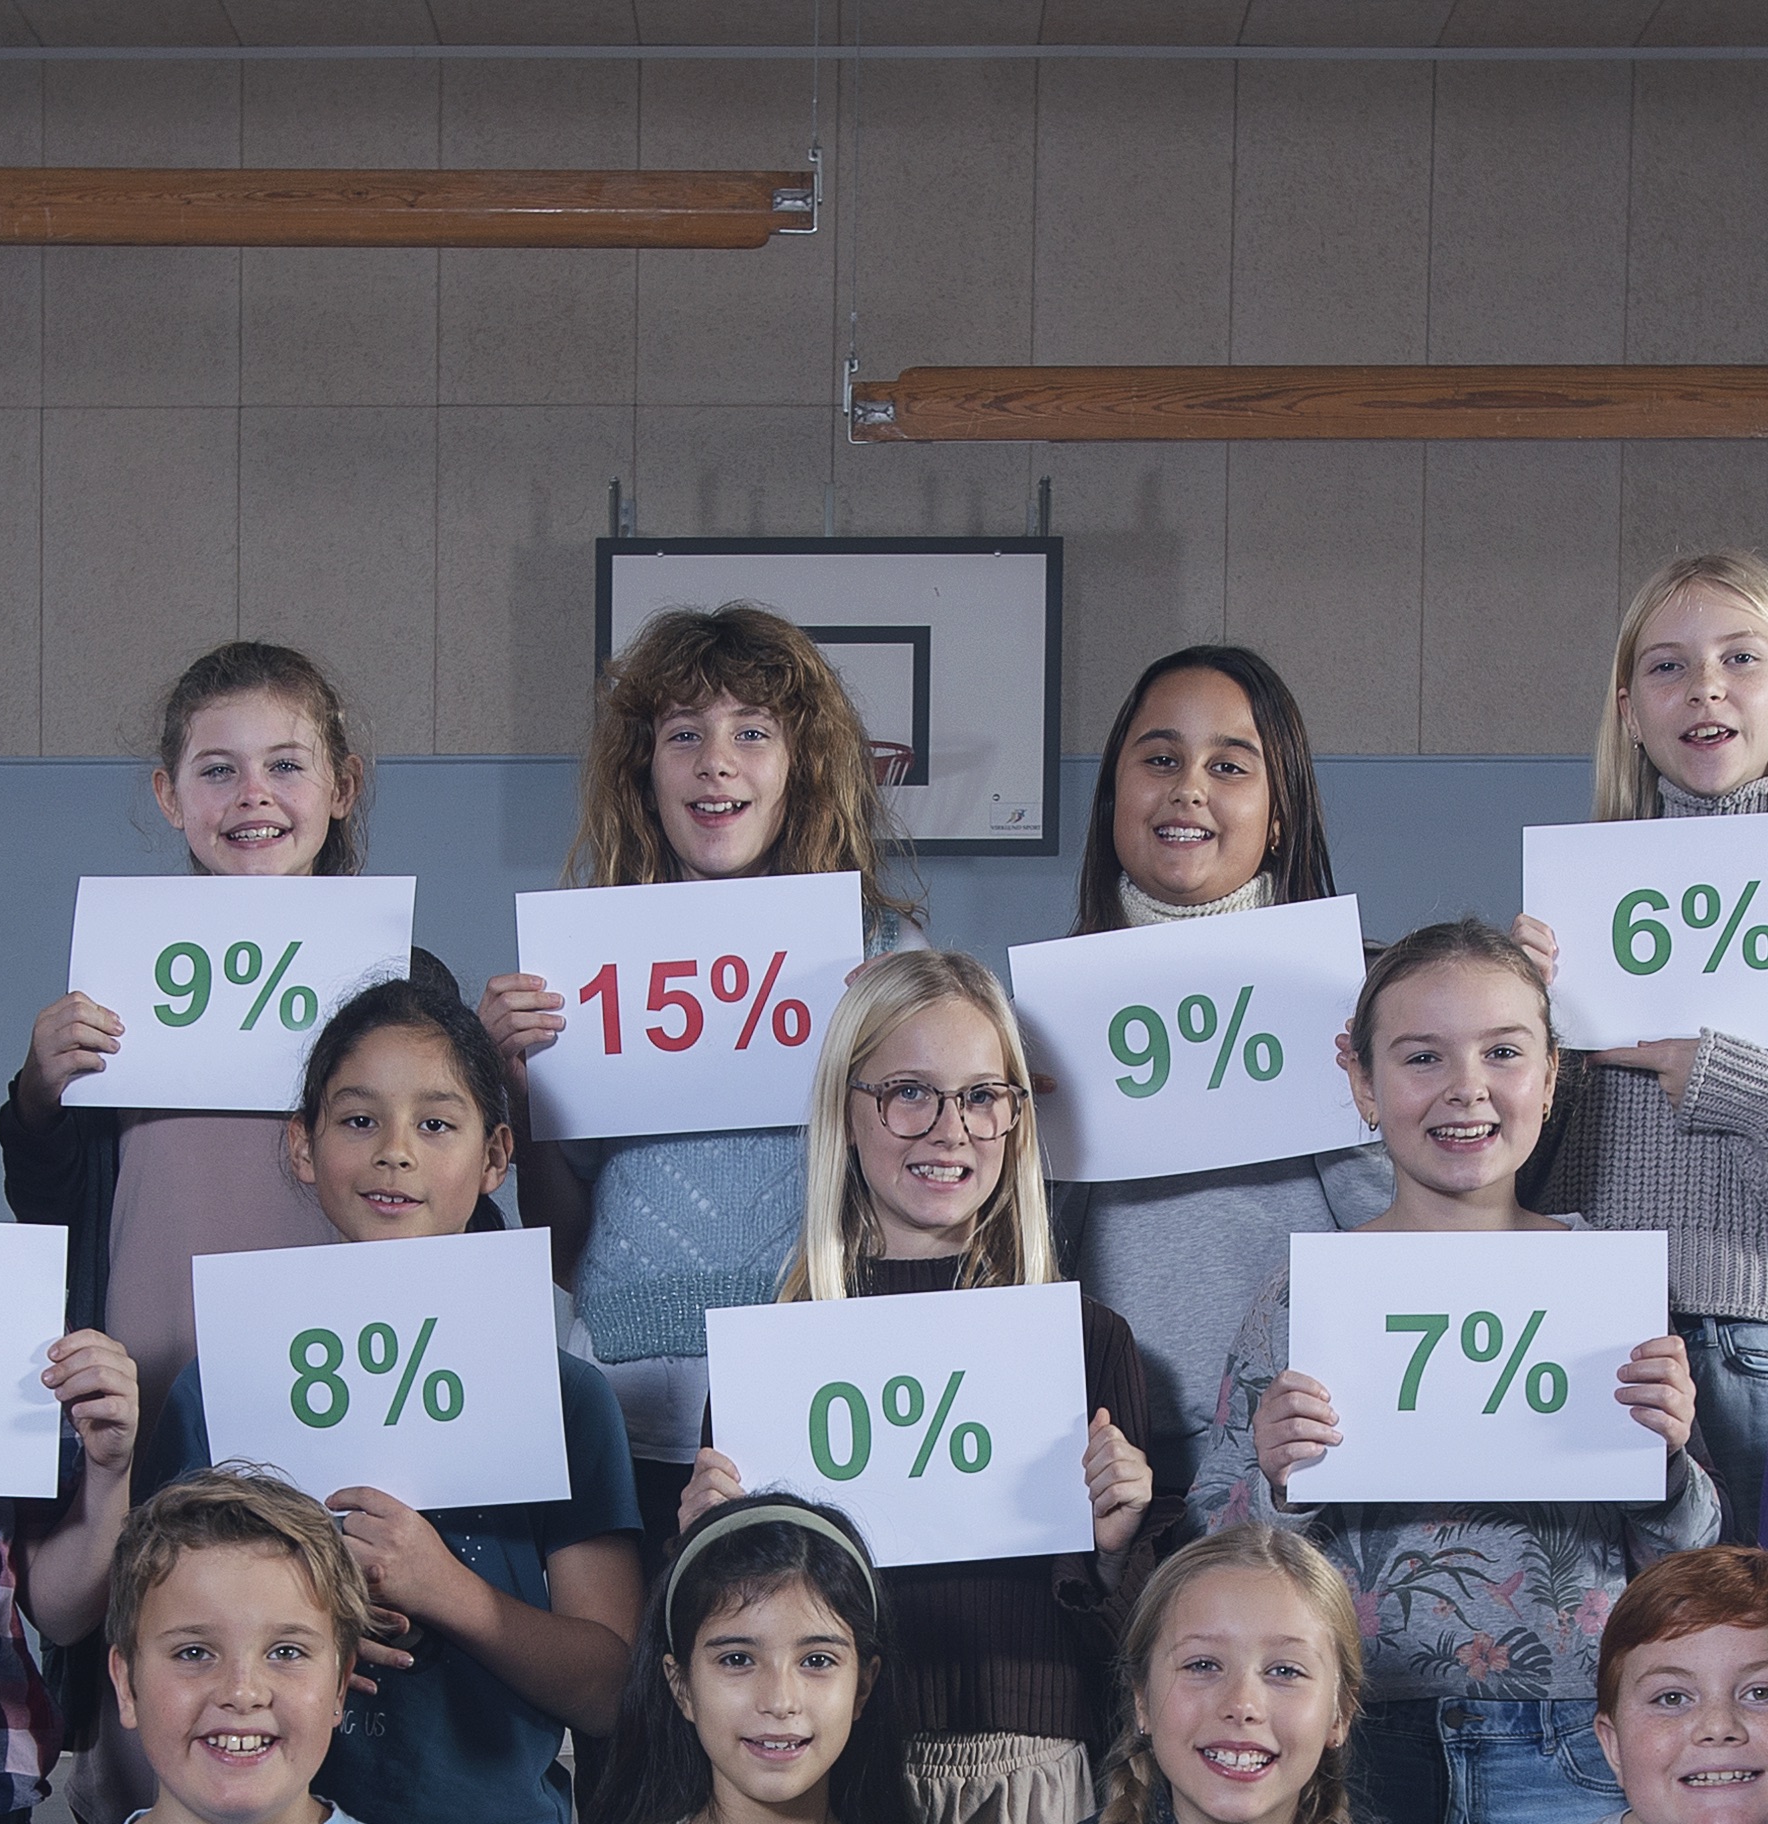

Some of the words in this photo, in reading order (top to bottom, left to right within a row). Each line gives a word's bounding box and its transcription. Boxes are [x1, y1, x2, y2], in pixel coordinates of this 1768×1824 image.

[154, 941, 316, 1028] 9%
[580, 951, 811, 1055] 15%
[1109, 987, 1283, 1098] 9%
[290, 1318, 462, 1428] 8%
[1387, 1311, 1567, 1413] 7%
[809, 1372, 991, 1480] 0%
[365, 1712, 385, 1737] US
